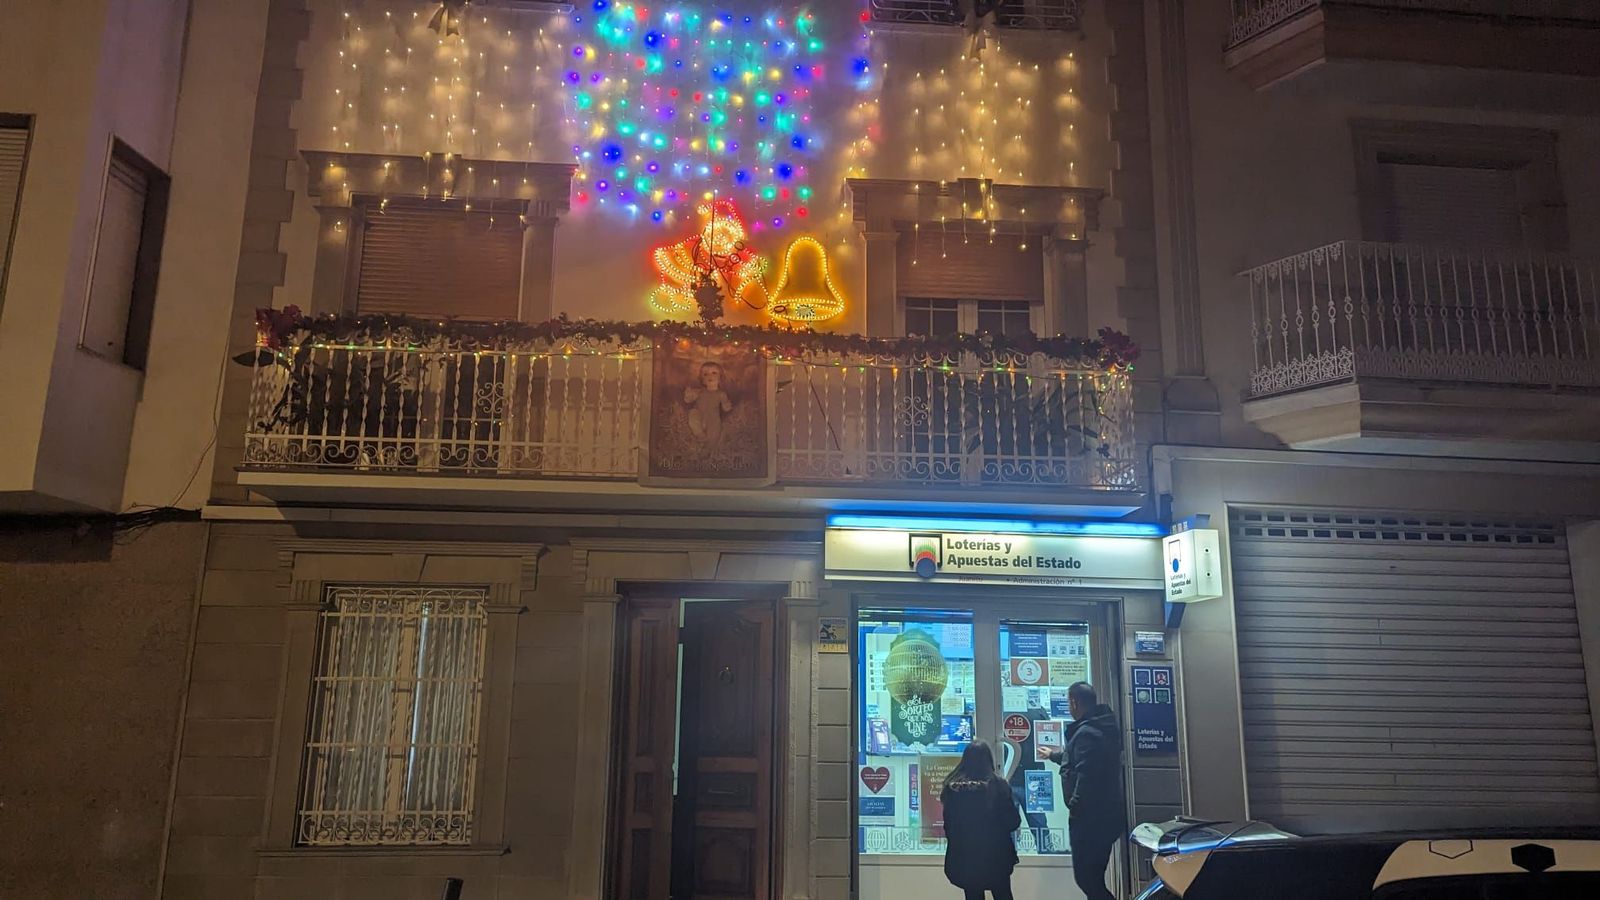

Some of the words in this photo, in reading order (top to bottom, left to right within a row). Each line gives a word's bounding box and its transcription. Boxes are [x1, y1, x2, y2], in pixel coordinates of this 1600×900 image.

[947, 538, 1000, 551] Loterías
[1004, 541, 1012, 554] y
[947, 554, 1008, 568] Apuestas
[1012, 555, 1032, 568] del
[1036, 557, 1081, 569] Estado
[1013, 576, 1065, 585] Administración
[1026, 667, 1033, 676] 3
[899, 703, 934, 719] SORTEO
[1009, 717, 1024, 727] +18
[1138, 735, 1163, 743] Apuestas
